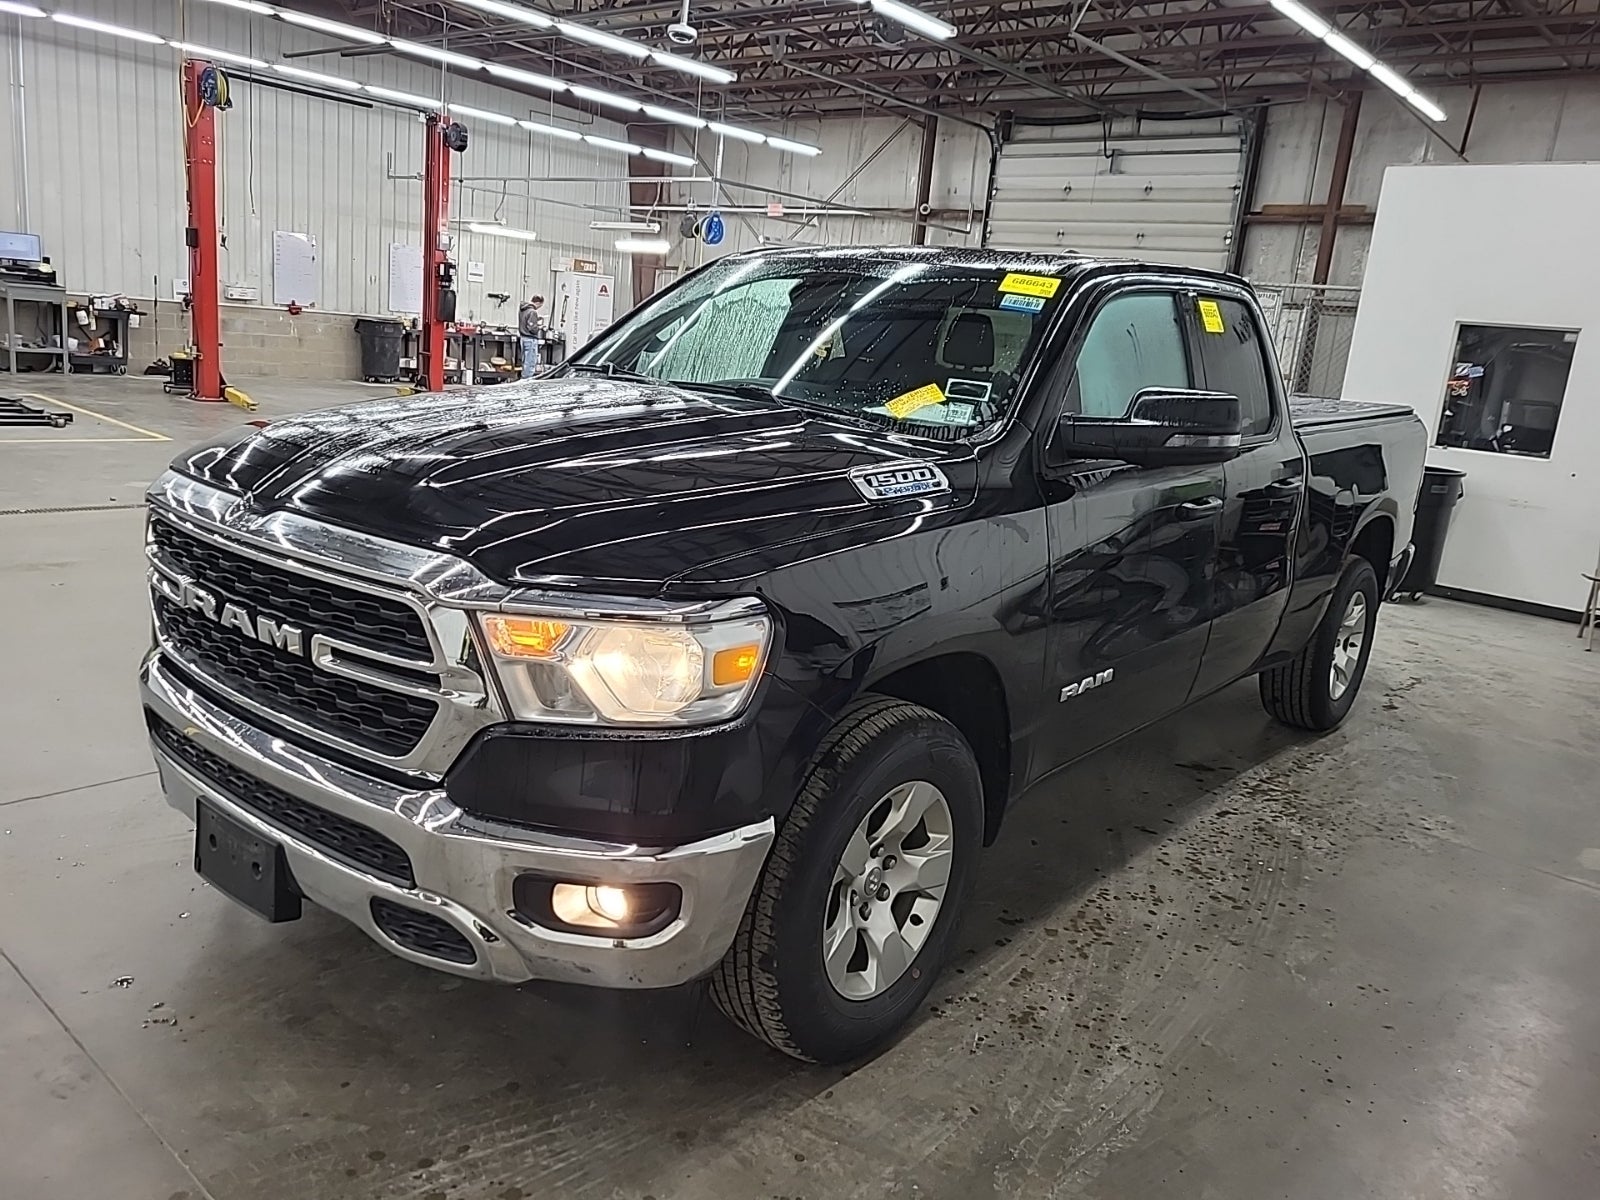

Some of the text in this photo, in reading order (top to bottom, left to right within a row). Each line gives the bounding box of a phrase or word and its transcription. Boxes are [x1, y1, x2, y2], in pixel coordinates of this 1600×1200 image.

[1012, 277, 1053, 289] 686643
[865, 468, 932, 488] 1500
[185, 583, 304, 657] RAM
[1060, 667, 1114, 703] RAM
